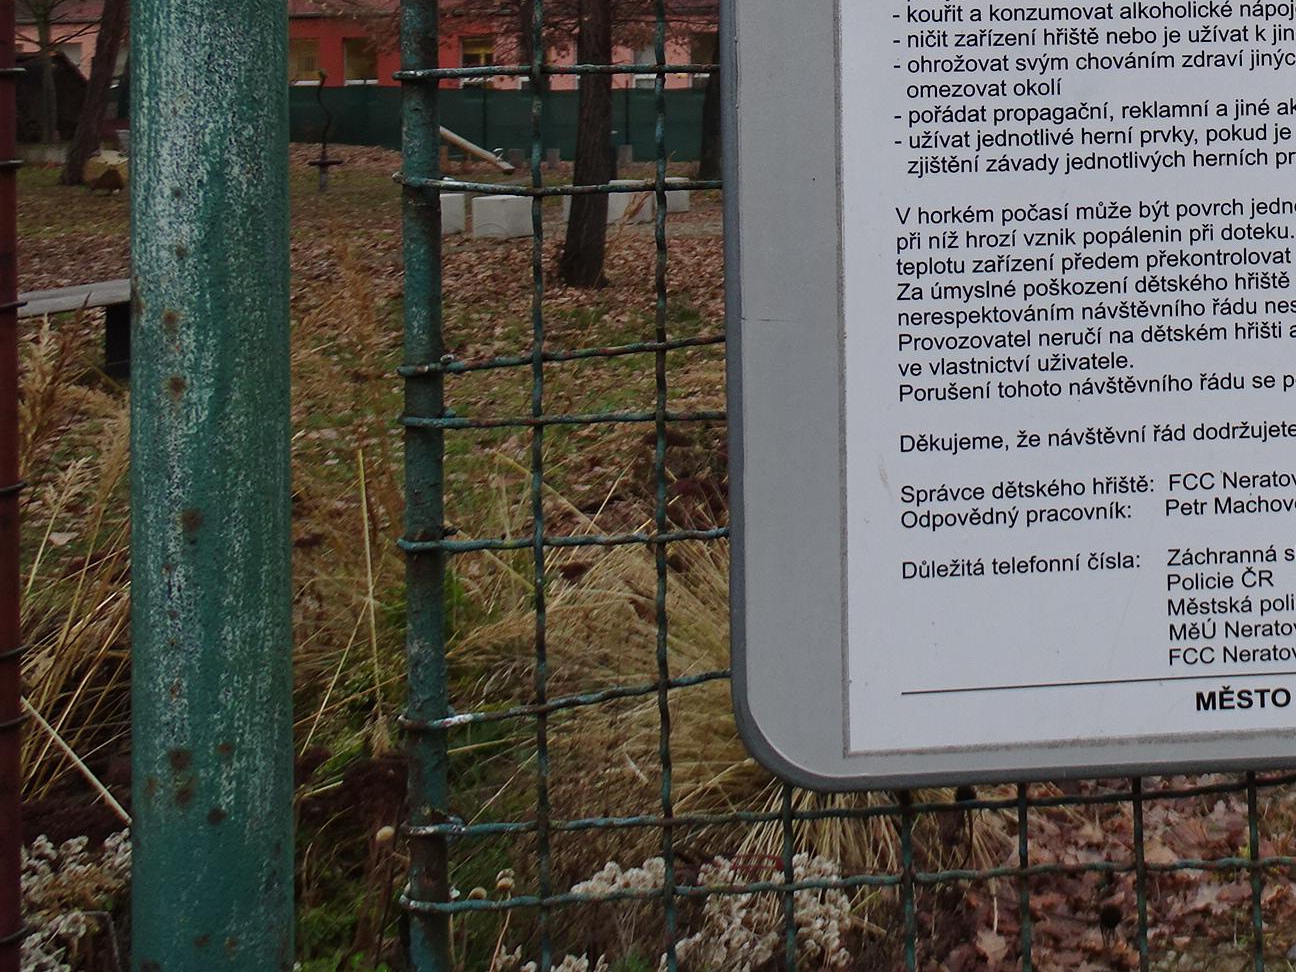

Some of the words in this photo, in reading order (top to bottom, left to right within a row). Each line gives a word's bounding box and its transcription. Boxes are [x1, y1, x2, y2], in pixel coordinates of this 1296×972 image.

[907, 4, 964, 23] kouřit
[969, 8, 982, 22] a
[989, 3, 1114, 22] konzumovat
[1119, 0, 1233, 20] alkoholické
[906, 79, 1008, 99] omezovat
[1013, 77, 1063, 97] okolí
[908, 104, 987, 129] pořádat
[993, 101, 1114, 126] propagační,
[1121, 99, 1210, 119] reklamní
[1215, 103, 1228, 117] a
[1233, 97, 1270, 121] jiné
[907, 154, 980, 179] zjištění
[985, 153, 1060, 176] závady
[1064, 150, 1186, 175] jednotlivých
[1193, 148, 1268, 167] herních
[895, 256, 965, 280] teplotu
[971, 253, 1055, 274] zařízení
[1061, 251, 1139, 276] předem
[1146, 247, 1292, 273] překontrolovat
[897, 362, 923, 377] ve
[928, 354, 1031, 376] vlastnictví
[1037, 351, 1134, 372] uživatele.
[900, 433, 1009, 456] Děkujeme,
[1016, 429, 1041, 448] že
[1048, 424, 1147, 447] návštěvní
[1153, 423, 1186, 442] řád
[900, 483, 985, 508] Správce
[991, 478, 1086, 500] dětského
[1093, 474, 1155, 495] hřiště:
[1169, 472, 1215, 492] FCC
[900, 505, 1020, 532] Odpovědný
[1026, 501, 1132, 528] pracovník:
[1165, 498, 1208, 517] Petr
[902, 557, 985, 580] Důležitá
[991, 553, 1081, 576] telefonní
[1087, 551, 1141, 571] čísla:
[1166, 544, 1278, 567] Záchranná
[1167, 571, 1234, 592] Policie
[1241, 566, 1275, 588] ČR
[1167, 594, 1253, 617] Městská
[1195, 685, 1291, 712] MĚSTO
